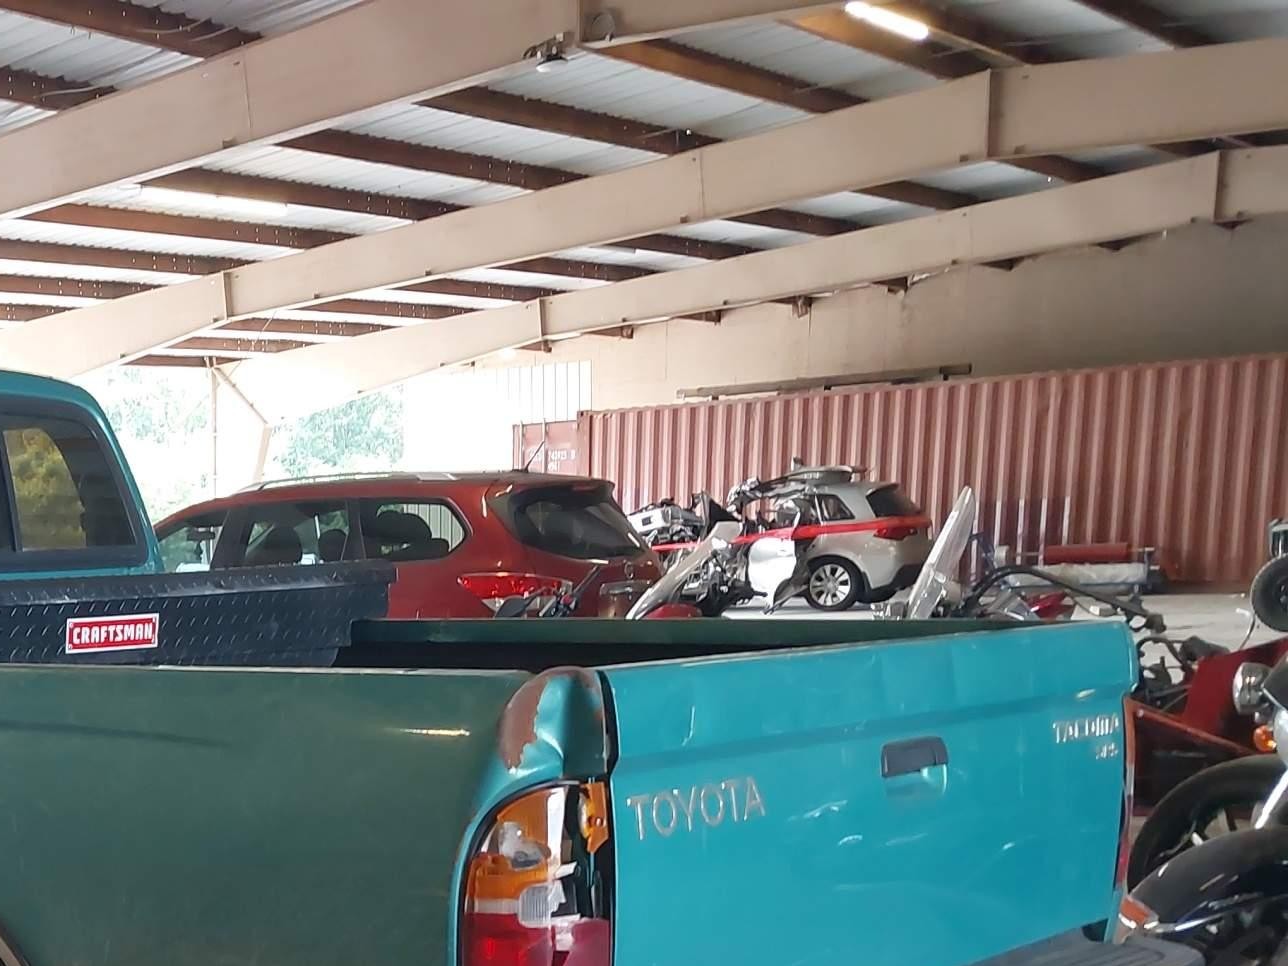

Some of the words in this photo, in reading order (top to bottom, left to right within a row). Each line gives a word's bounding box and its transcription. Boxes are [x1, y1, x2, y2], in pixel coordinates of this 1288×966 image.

[72, 622, 153, 644] CRAFTSMAN
[1052, 713, 1119, 743] TACOMA
[626, 776, 766, 840] TOYOTA
